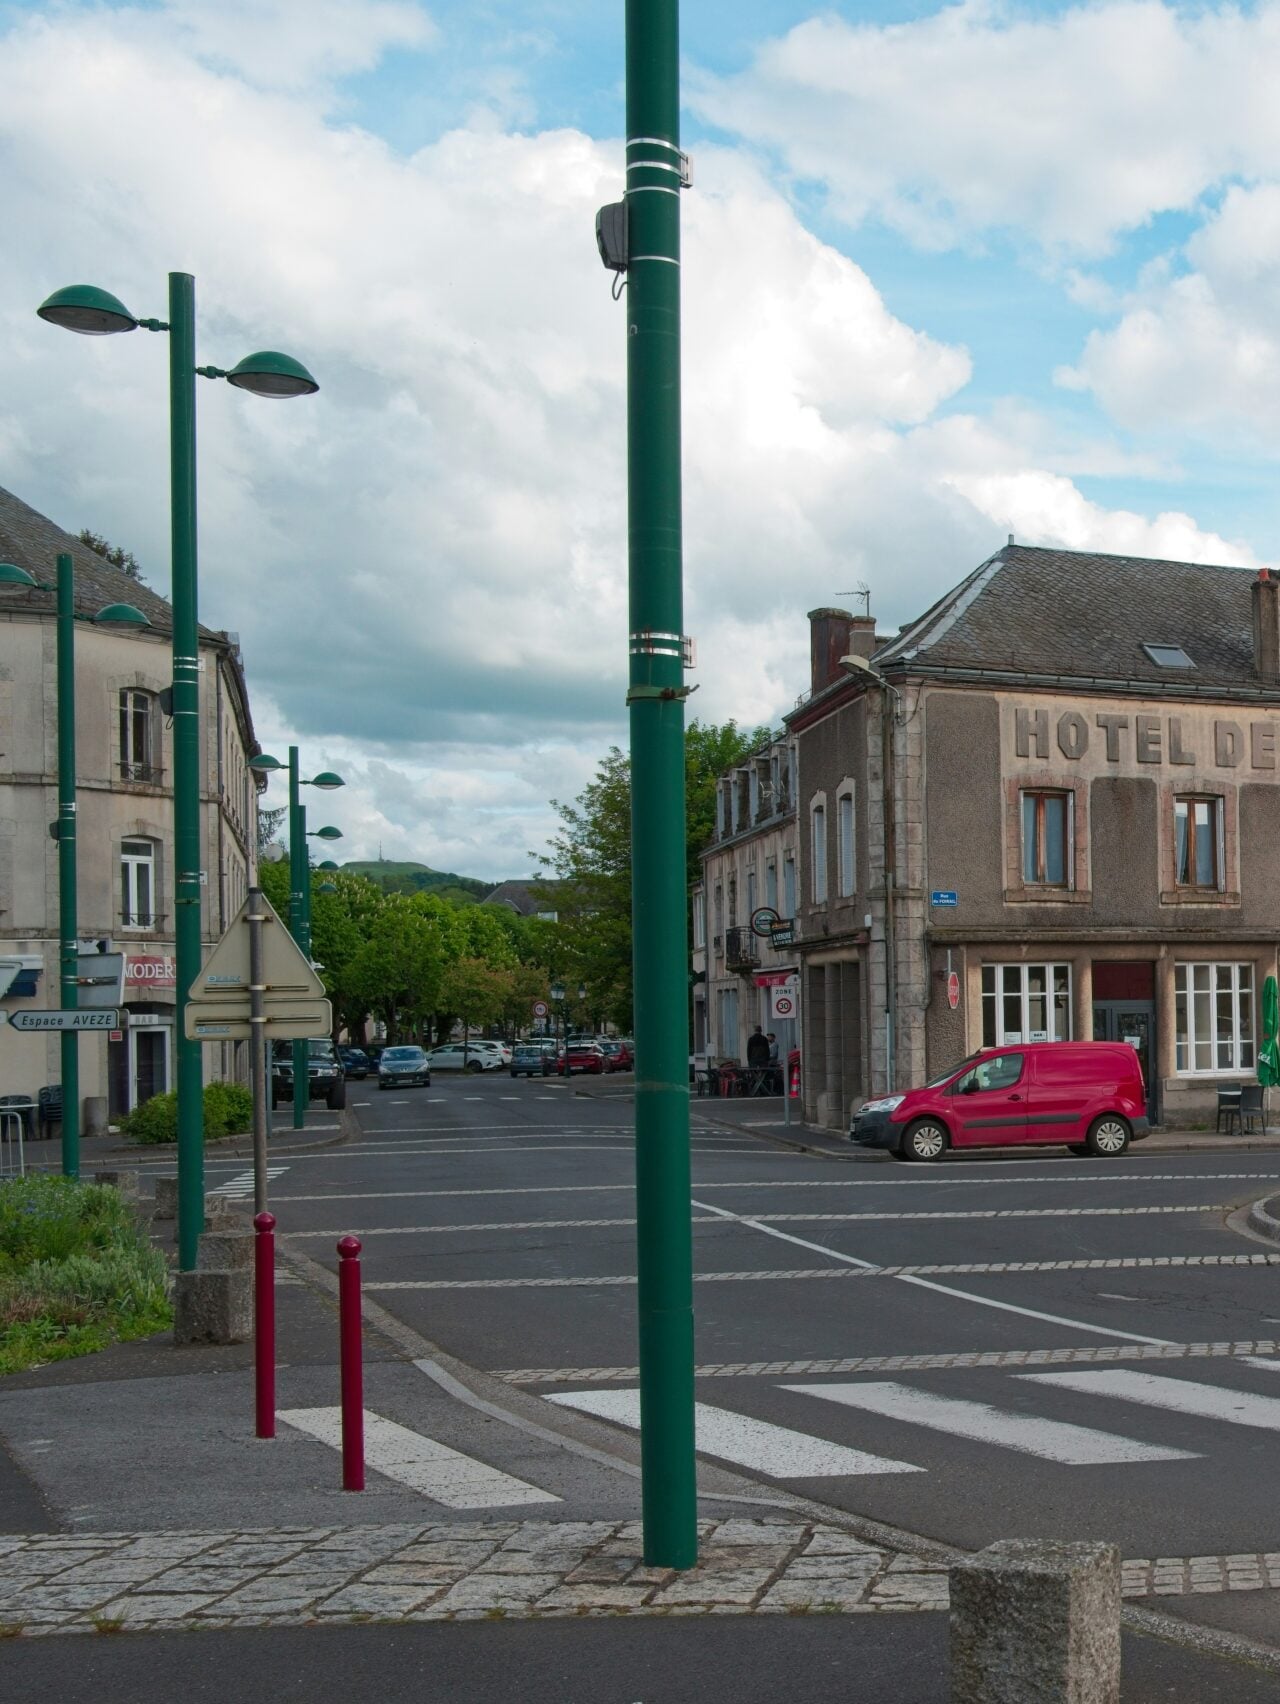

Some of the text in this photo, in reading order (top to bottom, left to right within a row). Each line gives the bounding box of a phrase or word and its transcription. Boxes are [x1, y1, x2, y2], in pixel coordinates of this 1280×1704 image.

[1015, 708, 1196, 765] HOTEL
[1214, 719, 1277, 769] DE
[122, 963, 176, 978] MODER
[779, 1002, 789, 1010] 30
[22, 1015, 112, 1027] Espace AVEZE
